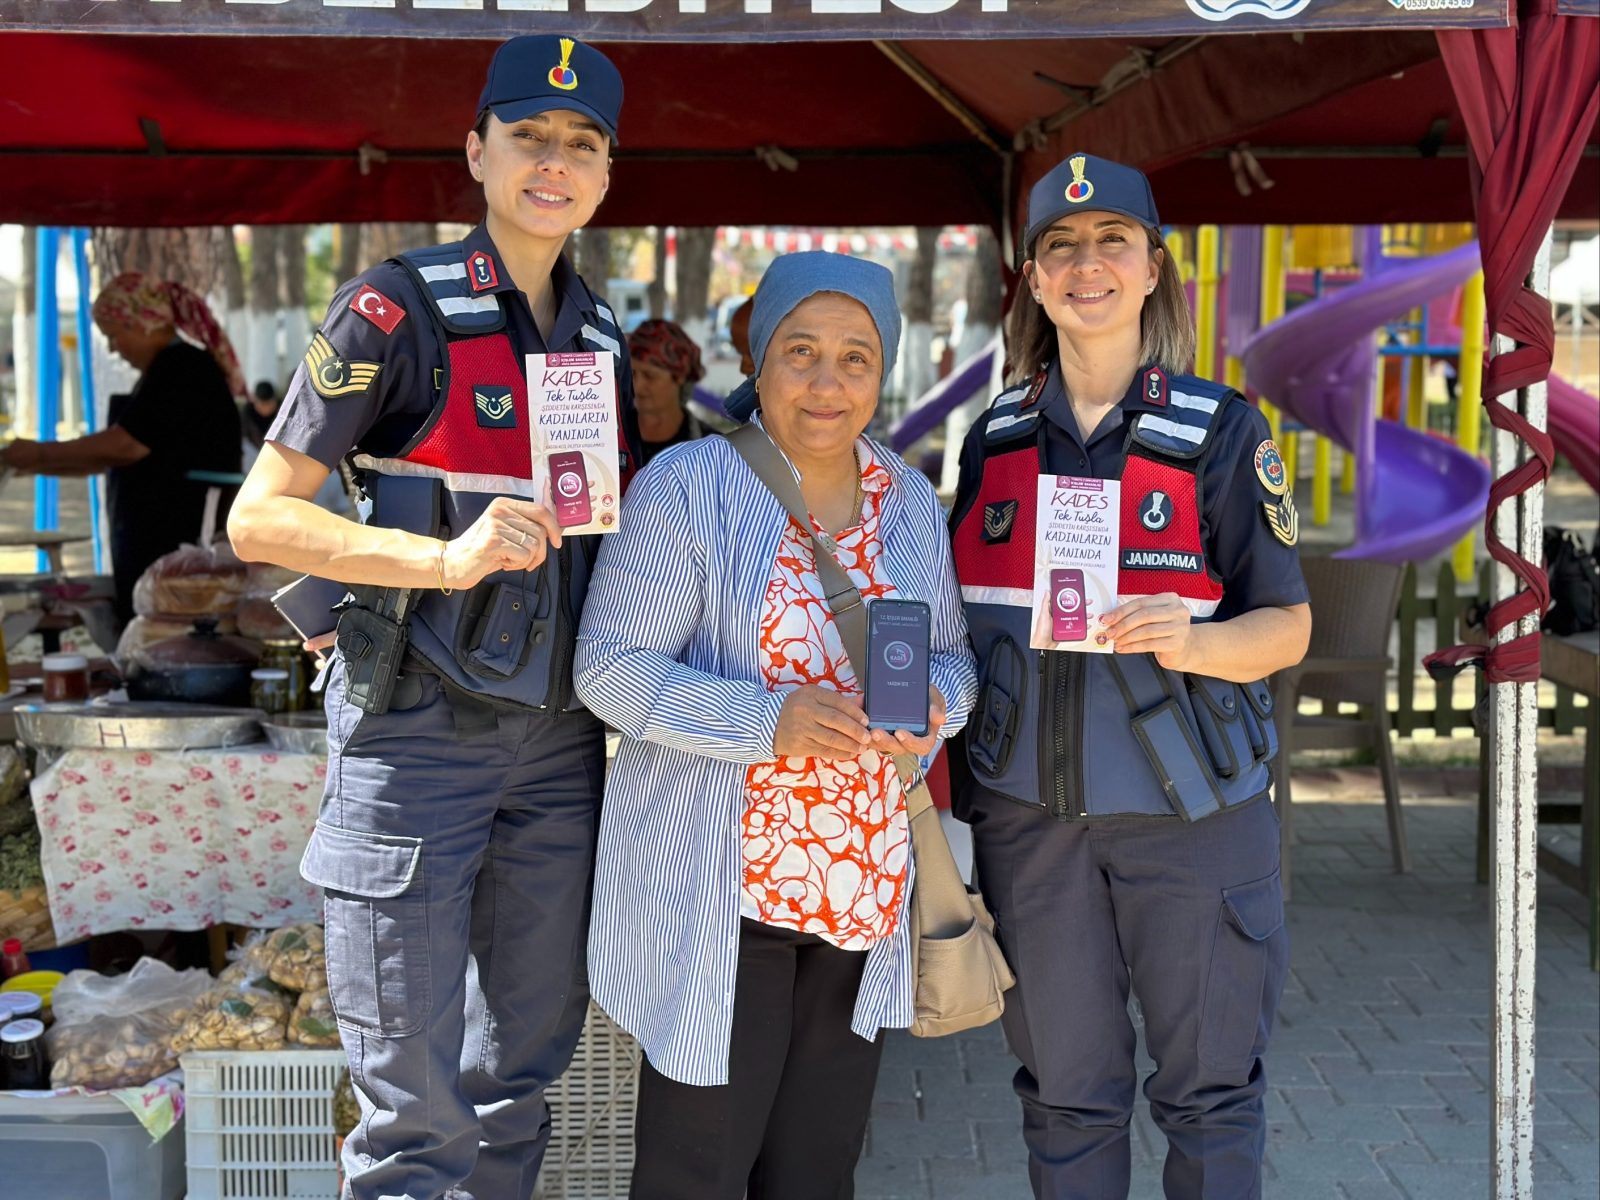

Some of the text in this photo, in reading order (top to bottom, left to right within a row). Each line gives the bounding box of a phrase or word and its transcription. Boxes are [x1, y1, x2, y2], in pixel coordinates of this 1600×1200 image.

[542, 370, 602, 387] KADES
[546, 388, 599, 402] Tek Tuşla
[540, 412, 609, 425] KADINLARIN
[550, 428, 600, 441] YANINDA
[1050, 490, 1108, 510] KADES
[1054, 509, 1104, 524] Tek Tuşla
[1045, 530, 1111, 546] KADINLARIN
[1054, 546, 1101, 560] YANINDA
[1126, 552, 1197, 570] JANDARMA
